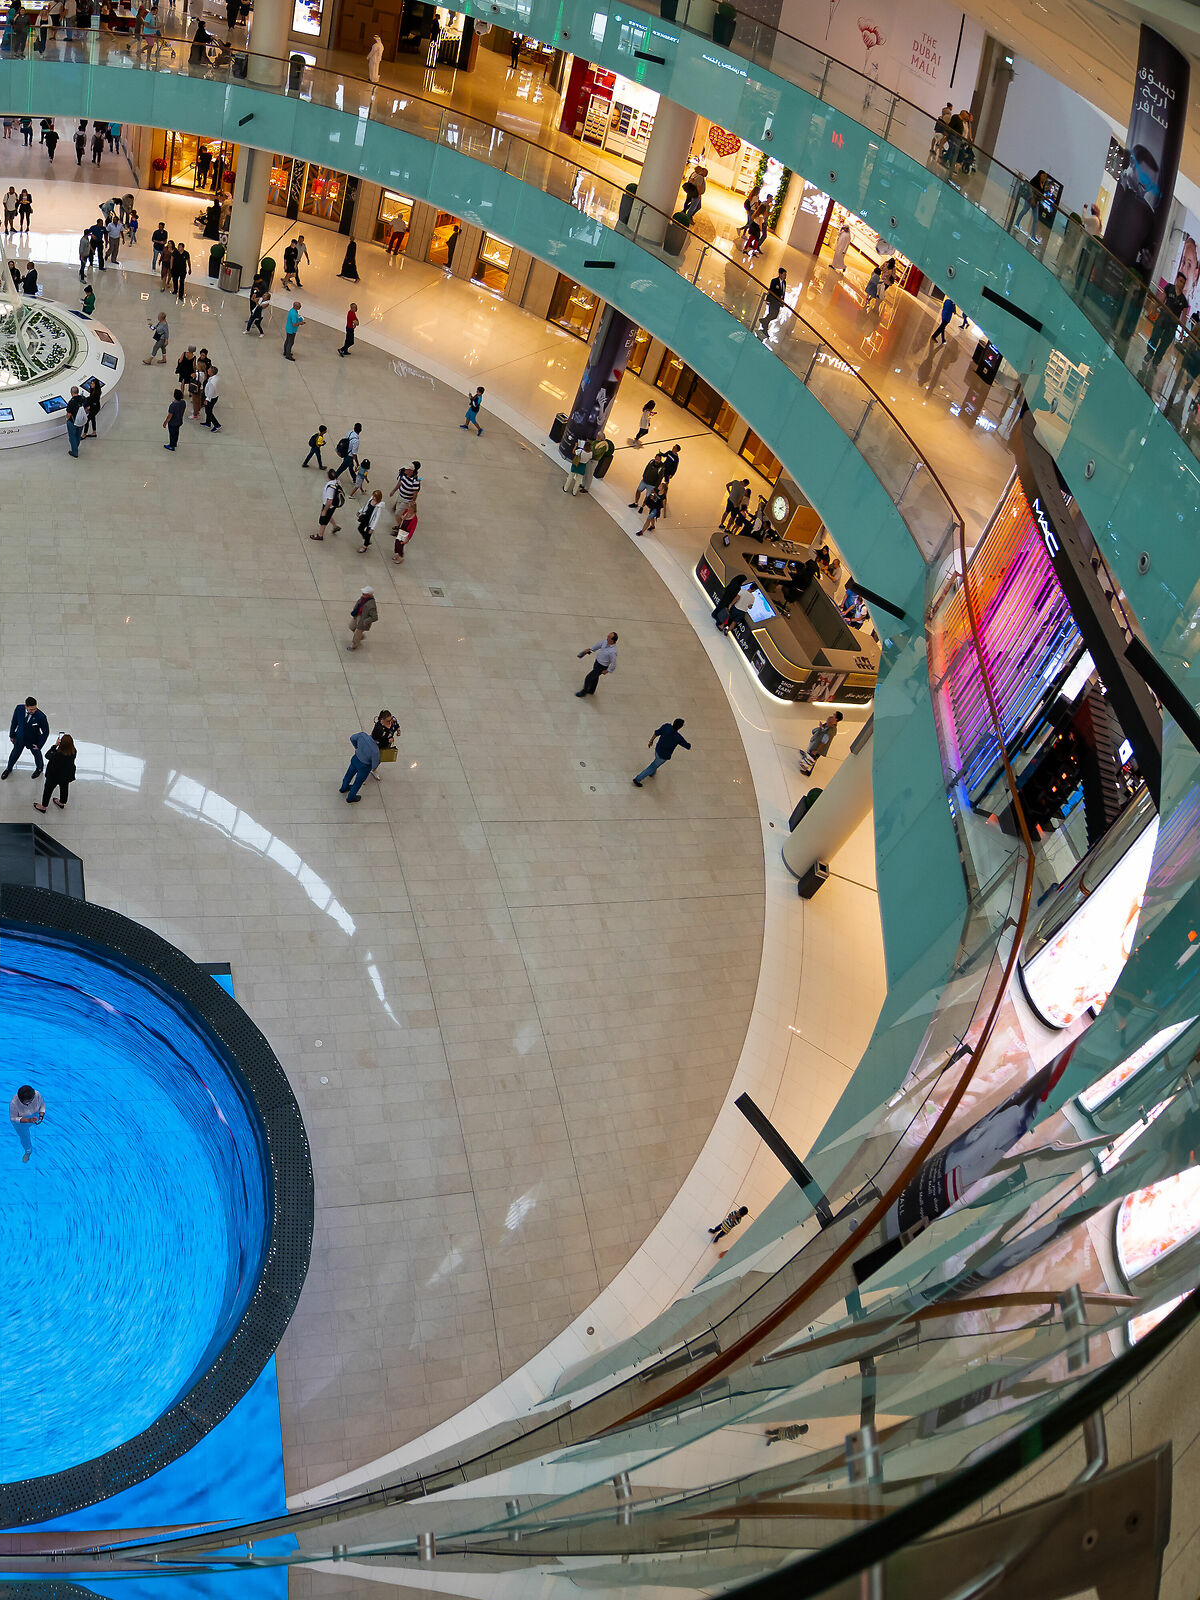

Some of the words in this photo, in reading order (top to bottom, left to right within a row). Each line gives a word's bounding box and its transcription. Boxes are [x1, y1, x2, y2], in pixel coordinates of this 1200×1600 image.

[912, 40, 941, 66] DUBAI
[922, 32, 937, 49] THE
[911, 54, 936, 79] MALL
